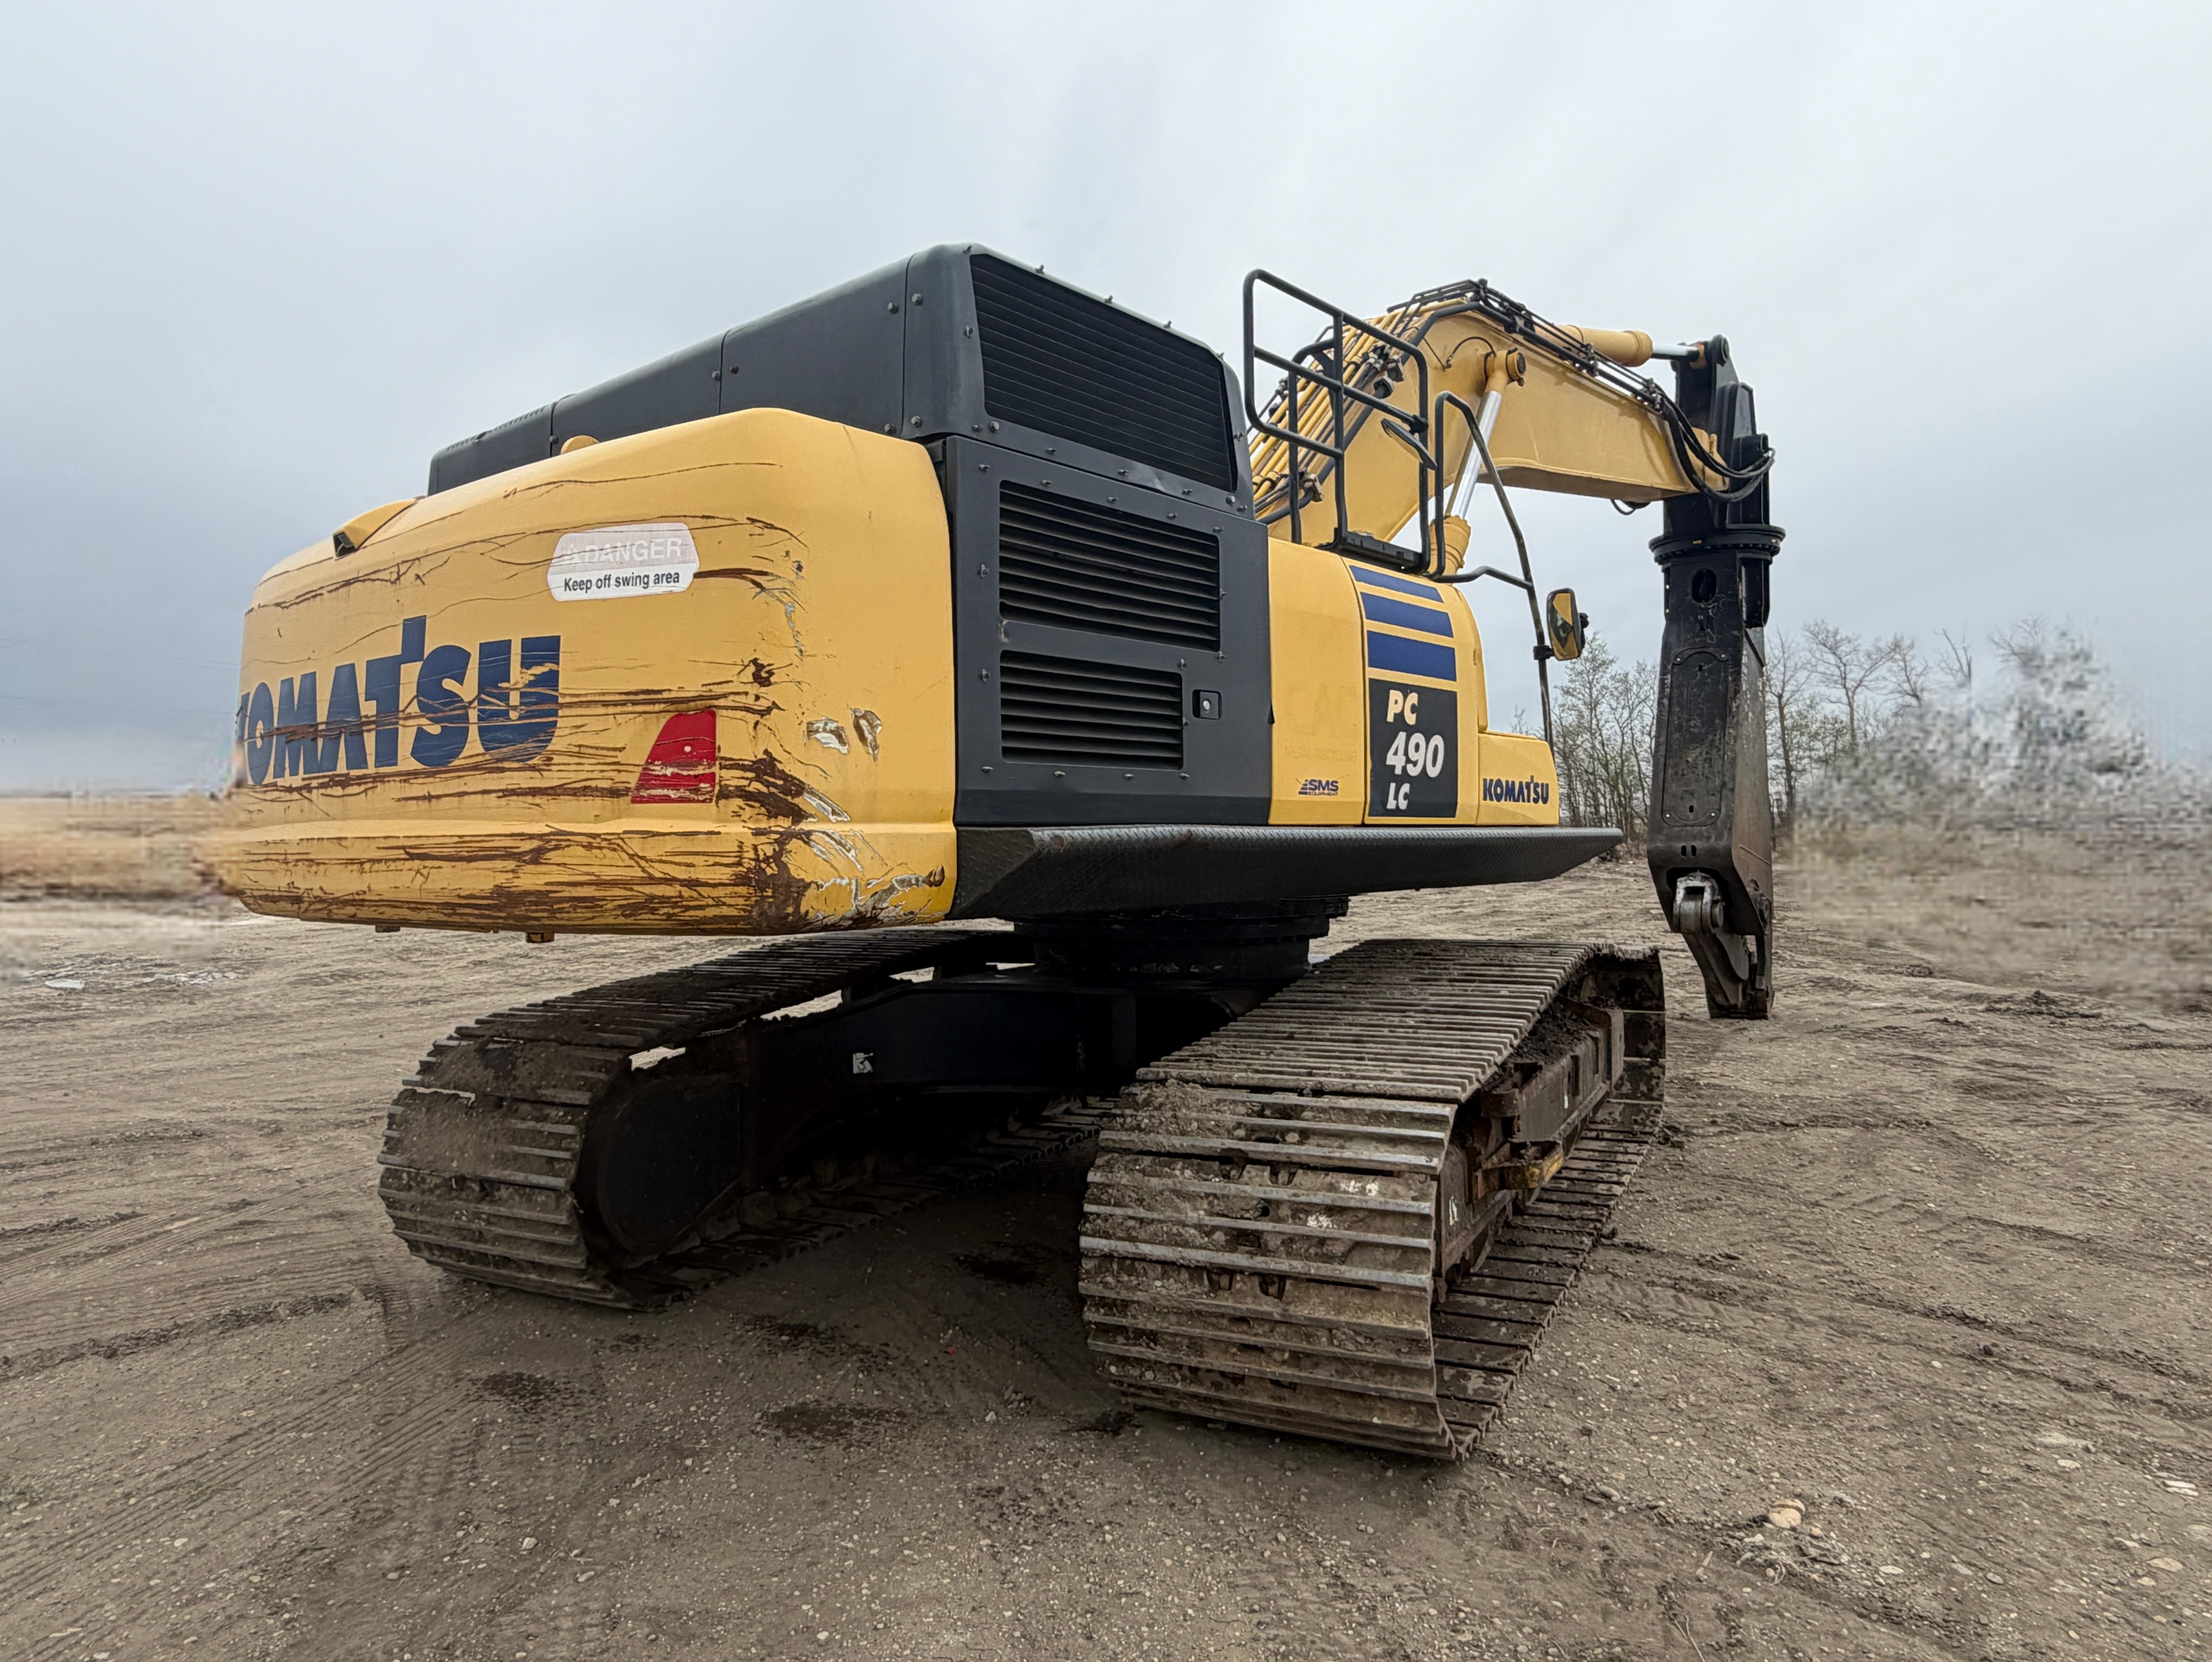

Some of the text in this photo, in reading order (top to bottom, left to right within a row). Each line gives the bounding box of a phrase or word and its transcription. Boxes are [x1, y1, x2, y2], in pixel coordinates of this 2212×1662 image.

[584, 537, 682, 562] DANGER
[564, 572, 680, 593] Keep off swing area
[1386, 689, 1419, 726] PC
[1385, 731, 1445, 778] 490
[1308, 779, 1339, 792] SMS
[1386, 782, 1411, 810] LC
[1482, 775, 1549, 805] KOMATSU
